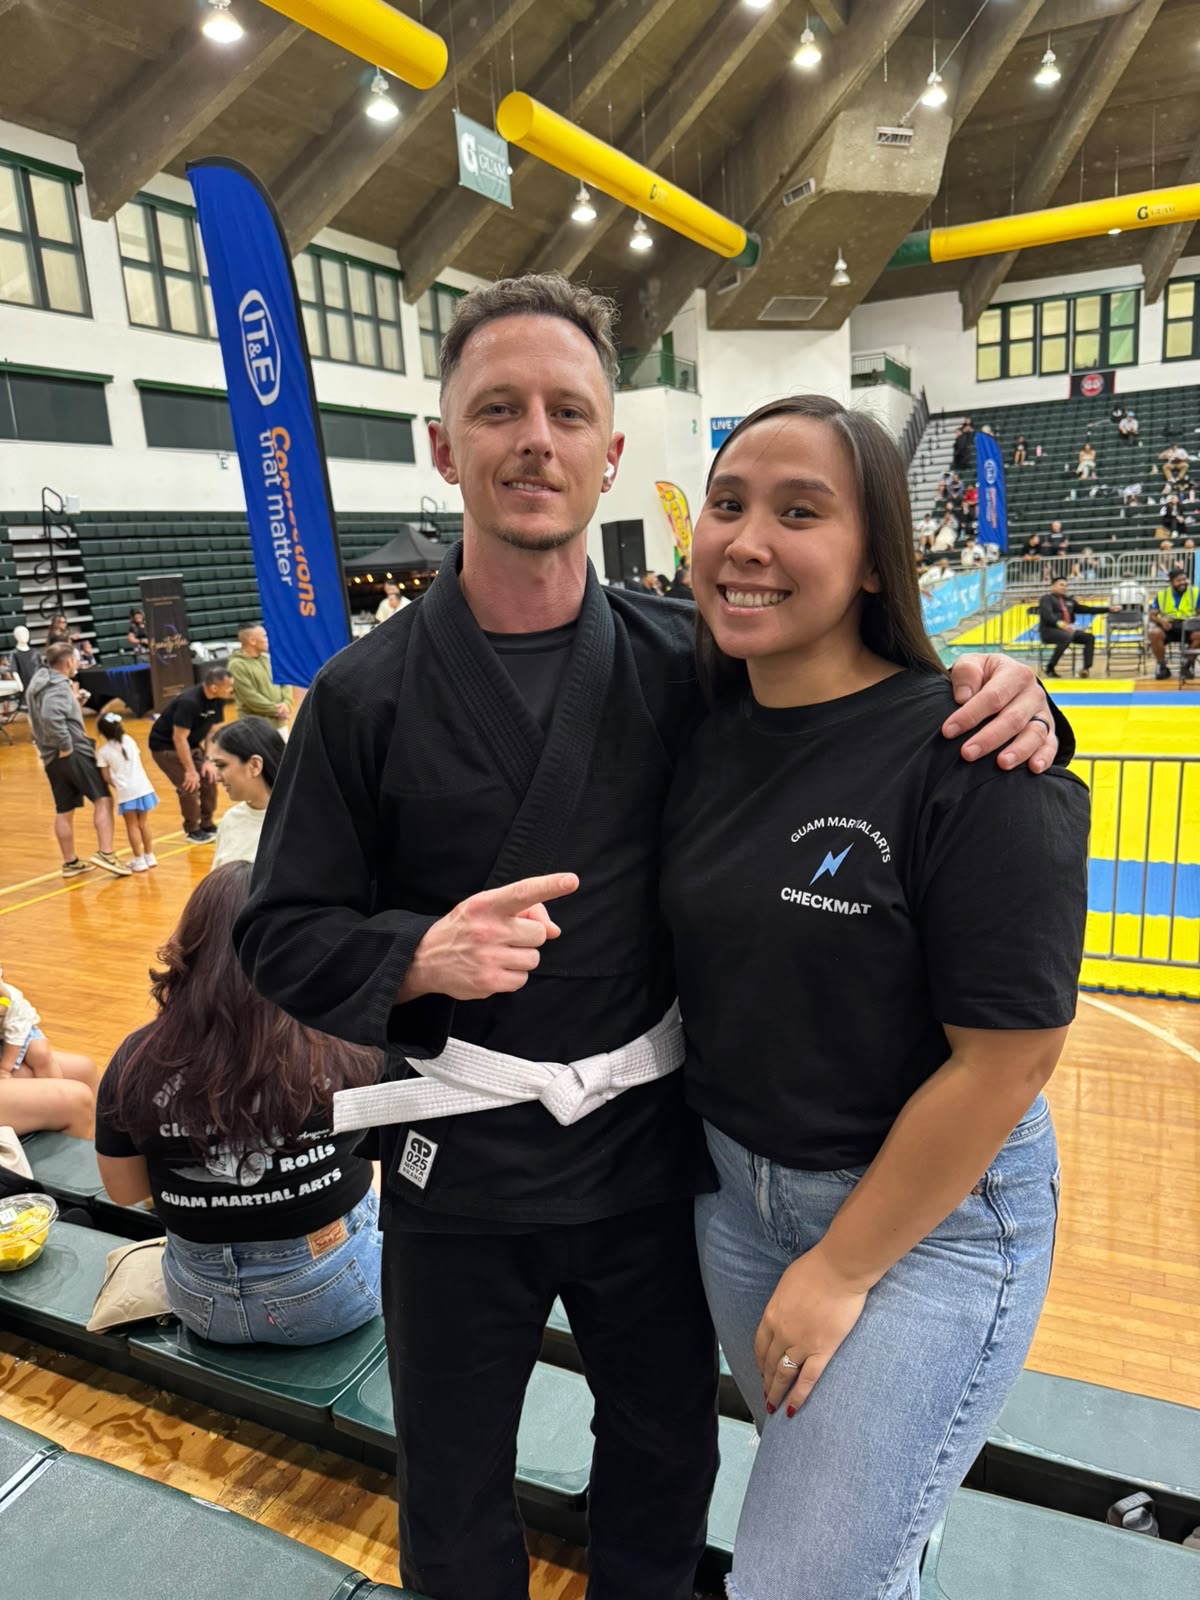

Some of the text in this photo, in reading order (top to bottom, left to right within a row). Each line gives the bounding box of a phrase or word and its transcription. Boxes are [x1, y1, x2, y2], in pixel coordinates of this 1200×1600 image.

[243, 308, 276, 386] IT&E
[267, 494, 293, 588] matter
[790, 817, 825, 843] GUAM
[869, 831, 891, 863] ARTS
[780, 886, 872, 916] CHECKMAT
[279, 1143, 337, 1173] Rolls
[407, 1151, 428, 1170] 025
[160, 1167, 343, 1208] GUAM MARTIAL ARTS
